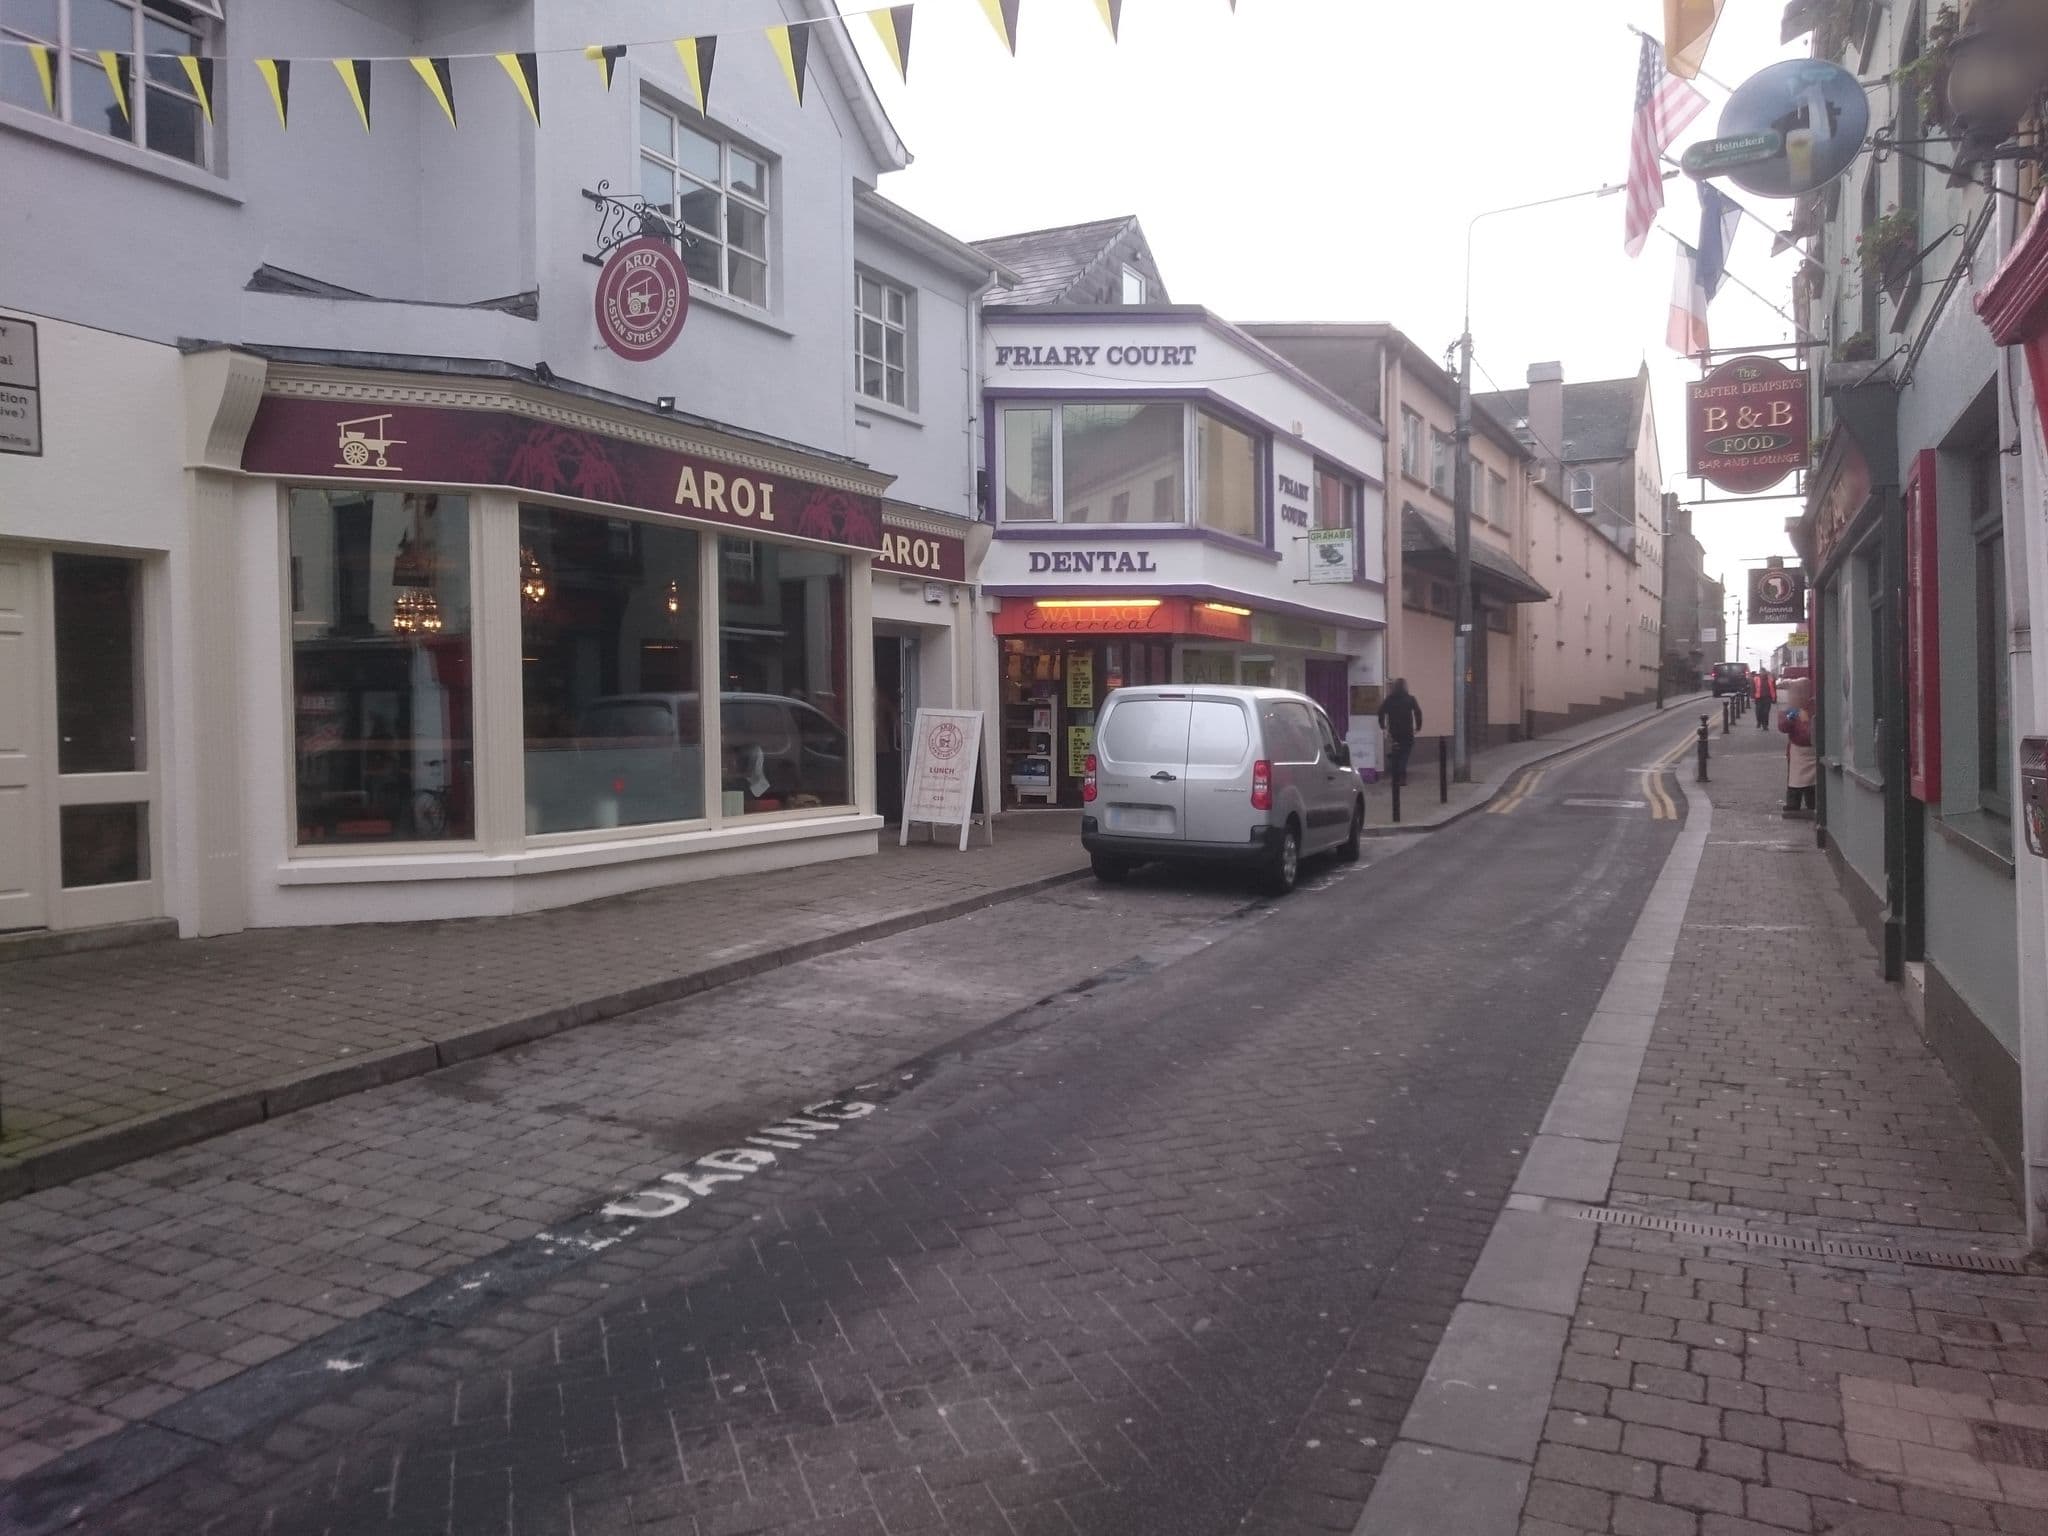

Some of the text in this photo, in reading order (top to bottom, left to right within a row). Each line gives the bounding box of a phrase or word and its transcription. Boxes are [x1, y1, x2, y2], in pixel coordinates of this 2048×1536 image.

[1715, 135, 1765, 153] Heineken
[625, 253, 660, 273] AROI
[607, 288, 676, 344] ASIAN STREET FOOD
[995, 345, 1197, 366] FRIARY COURT
[1737, 367, 1757, 379] The
[1693, 378, 1802, 399] RAFTER DEMPSEYS
[1703, 400, 1793, 433] B & B
[1722, 436, 1774, 452] FOOD
[1698, 453, 1801, 470] BAR AND LOUNGE
[675, 465, 775, 522] AROI
[1278, 474, 1310, 502] FRIARY
[1281, 503, 1309, 528] COURT
[1310, 530, 1352, 541] GRAHAMS
[879, 532, 941, 571] AROI
[1029, 551, 1157, 574] DENTAL
[1038, 607, 1150, 621] WALLACE
[929, 767, 955, 775] LUNCH
